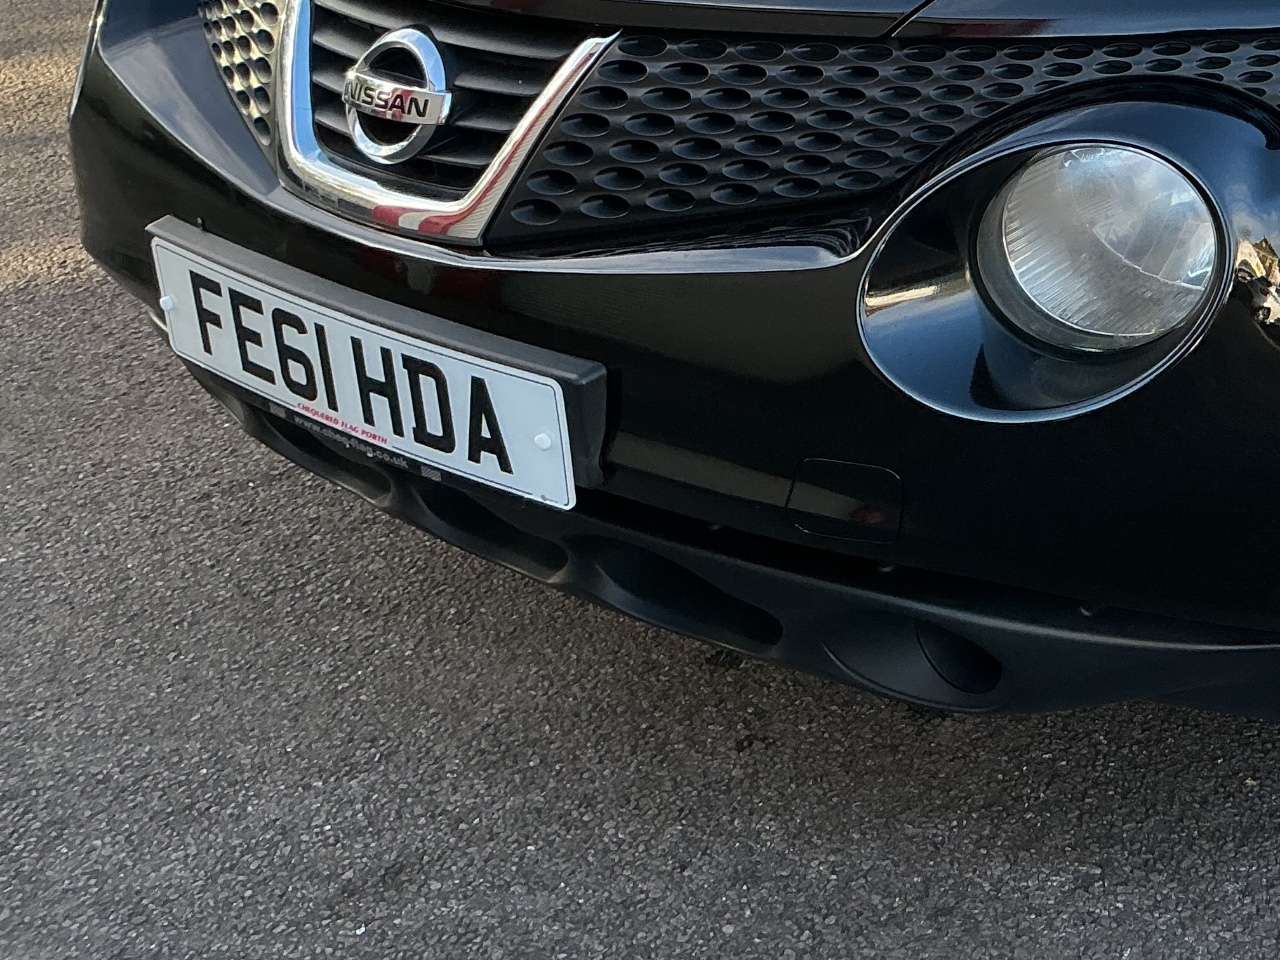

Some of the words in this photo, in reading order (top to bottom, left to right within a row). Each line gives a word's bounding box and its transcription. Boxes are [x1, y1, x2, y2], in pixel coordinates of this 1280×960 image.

[344, 80, 429, 118] NISSAN
[189, 269, 338, 412] FE61
[350, 336, 513, 475] HDA
